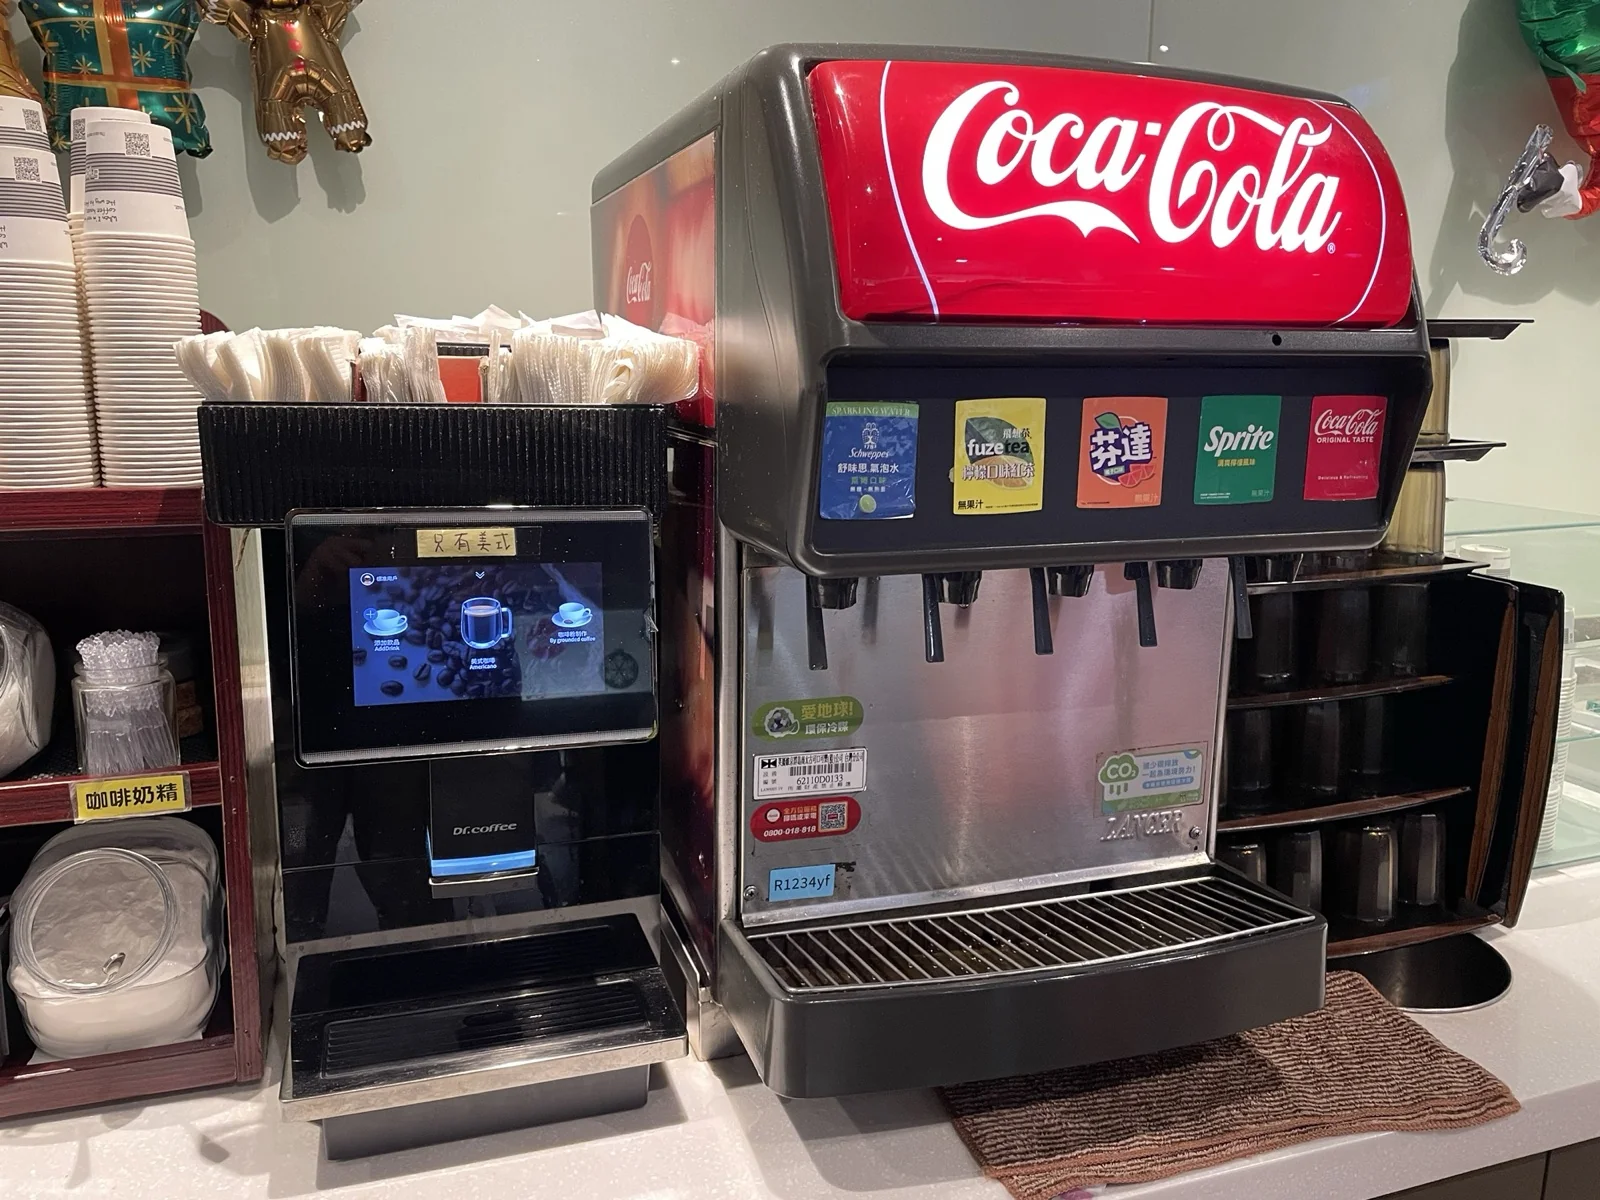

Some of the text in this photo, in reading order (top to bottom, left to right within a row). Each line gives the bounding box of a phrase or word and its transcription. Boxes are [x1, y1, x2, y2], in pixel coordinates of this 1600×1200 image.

[922, 81, 1342, 253] Coca-Cola
[832, 406, 911, 416] SPARKLING WATER
[1314, 409, 1383, 436] Coca-Cola
[1091, 424, 1151, 470] 芬達
[1204, 424, 1274, 457] Sprite
[849, 447, 890, 459] Schweppes
[962, 462, 1035, 480] 檸檬口味紅茶
[958, 500, 984, 510] 無果汁
[433, 531, 511, 553] 只有美式
[796, 774, 844, 785] 62110D0133
[85, 782, 178, 810] 咖啡奶精
[453, 823, 518, 836] Dr.coffee
[774, 874, 831, 892] R1234yf
